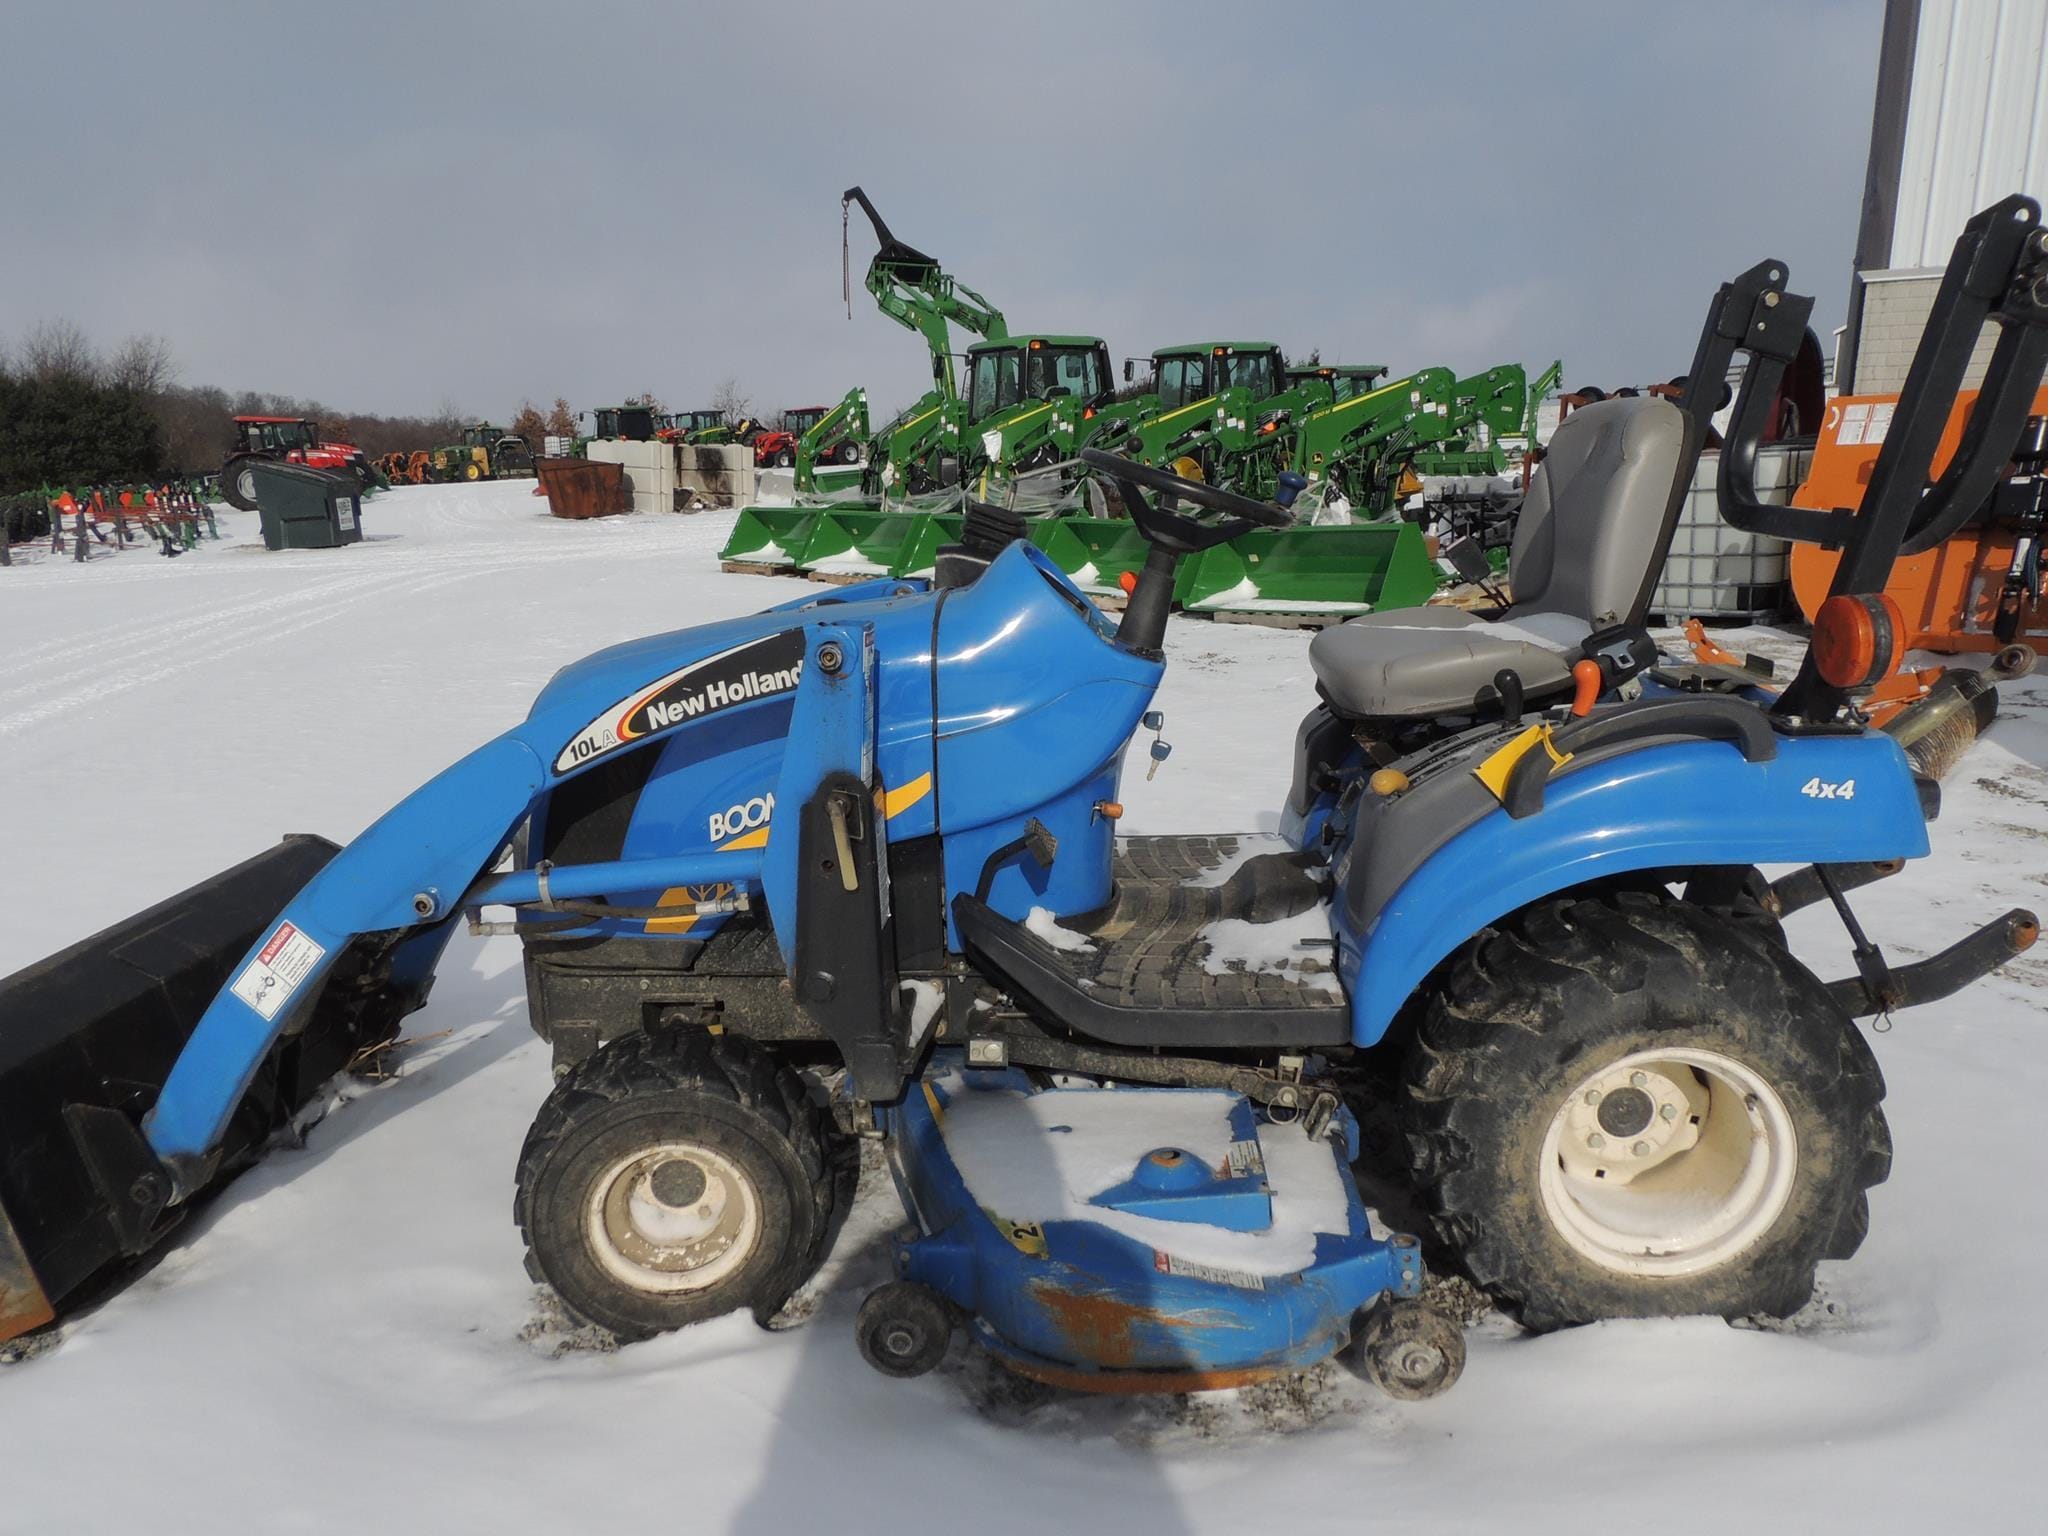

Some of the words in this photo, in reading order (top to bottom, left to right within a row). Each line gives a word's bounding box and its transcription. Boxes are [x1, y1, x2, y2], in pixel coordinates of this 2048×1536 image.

[646, 693, 705, 730] New
[706, 660, 803, 708] Holland
[570, 728, 617, 762] 10LA
[1801, 777, 1855, 800] 4x4
